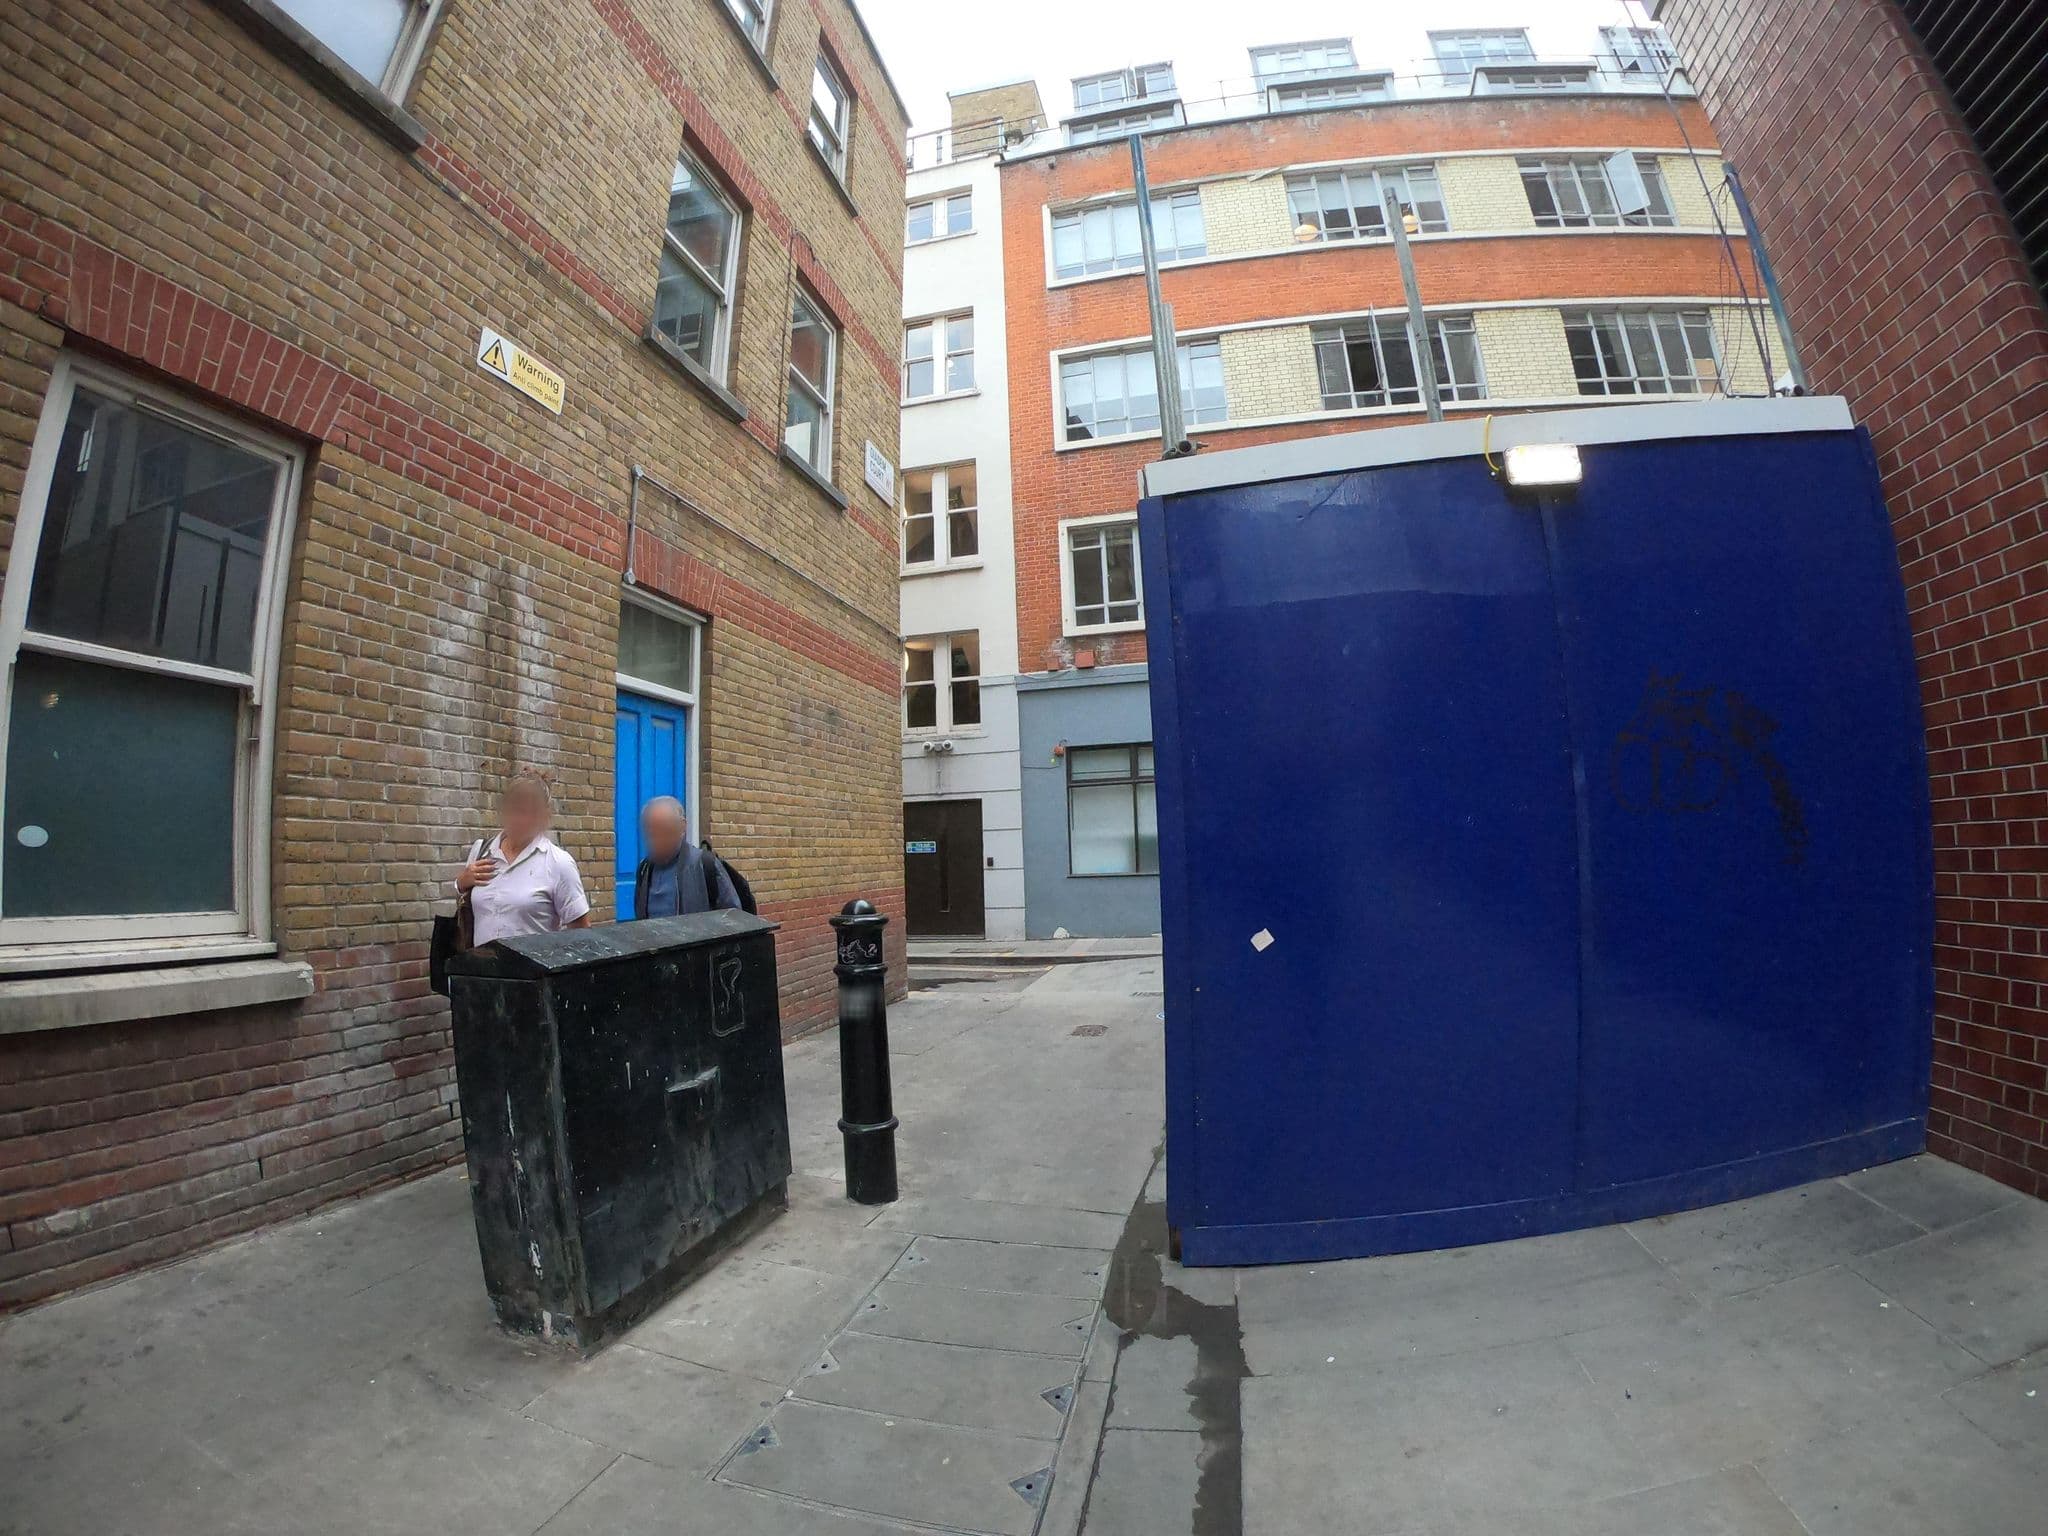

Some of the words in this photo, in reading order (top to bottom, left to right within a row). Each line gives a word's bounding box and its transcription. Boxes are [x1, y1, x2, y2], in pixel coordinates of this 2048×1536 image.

[513, 371, 526, 385] Anti
[526, 380, 544, 396] climb
[544, 392, 560, 407] paint
[517, 353, 560, 394] Warning
